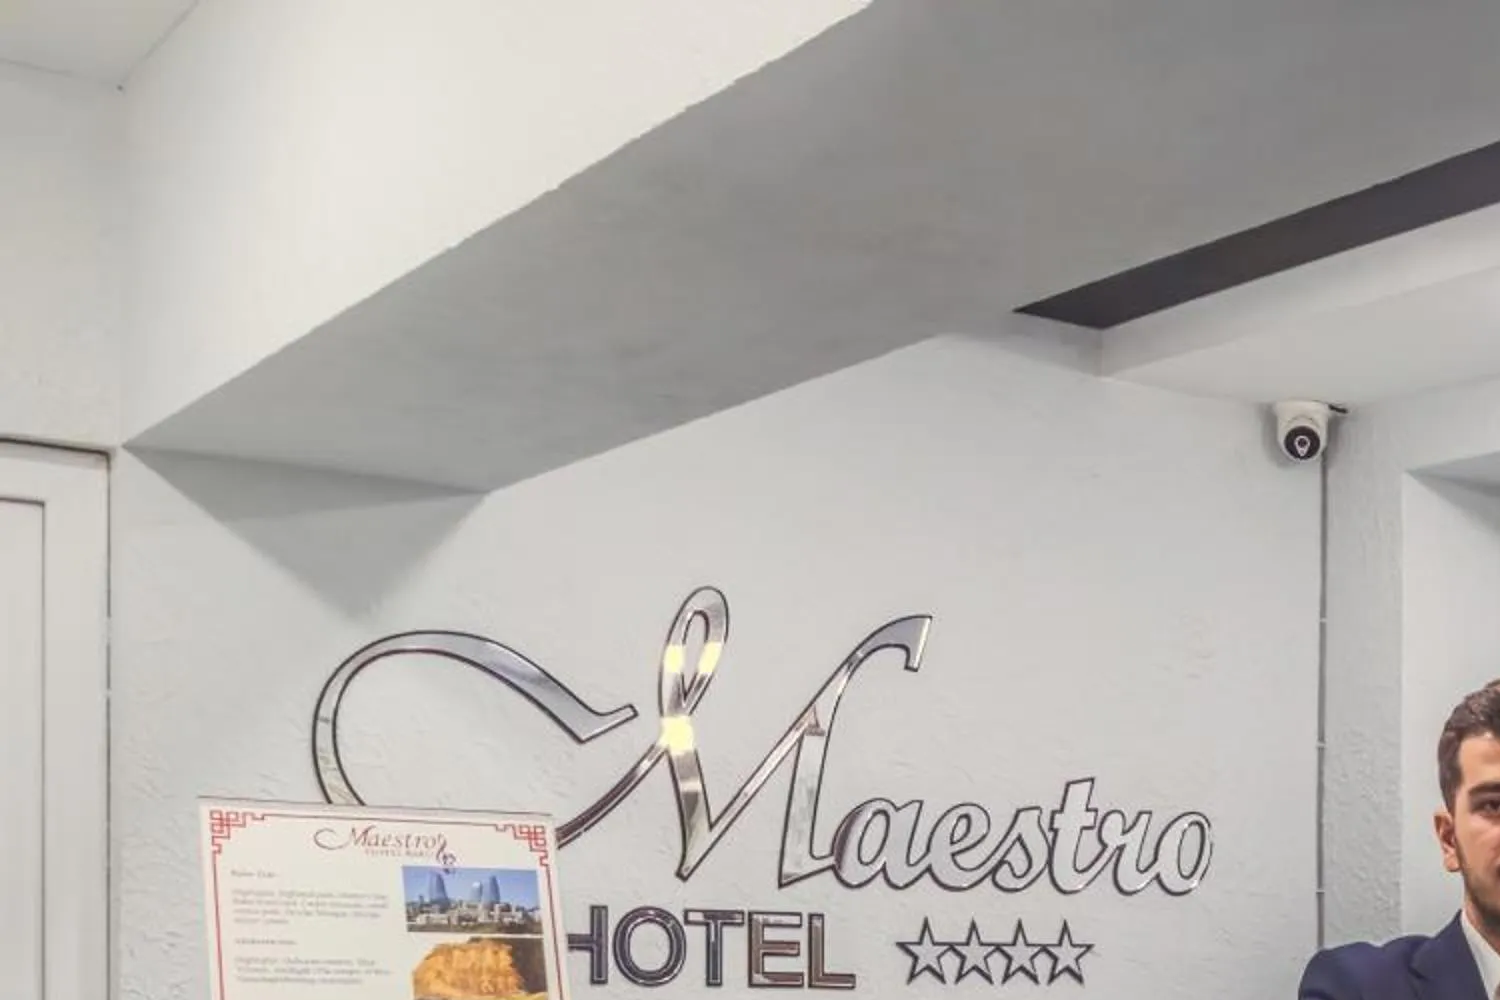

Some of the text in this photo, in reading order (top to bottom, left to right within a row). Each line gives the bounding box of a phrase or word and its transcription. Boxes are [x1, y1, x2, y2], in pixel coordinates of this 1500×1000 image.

[311, 585, 1215, 896] Maestro
[313, 825, 438, 851] Maestro
[566, 904, 857, 991] HOTEL
